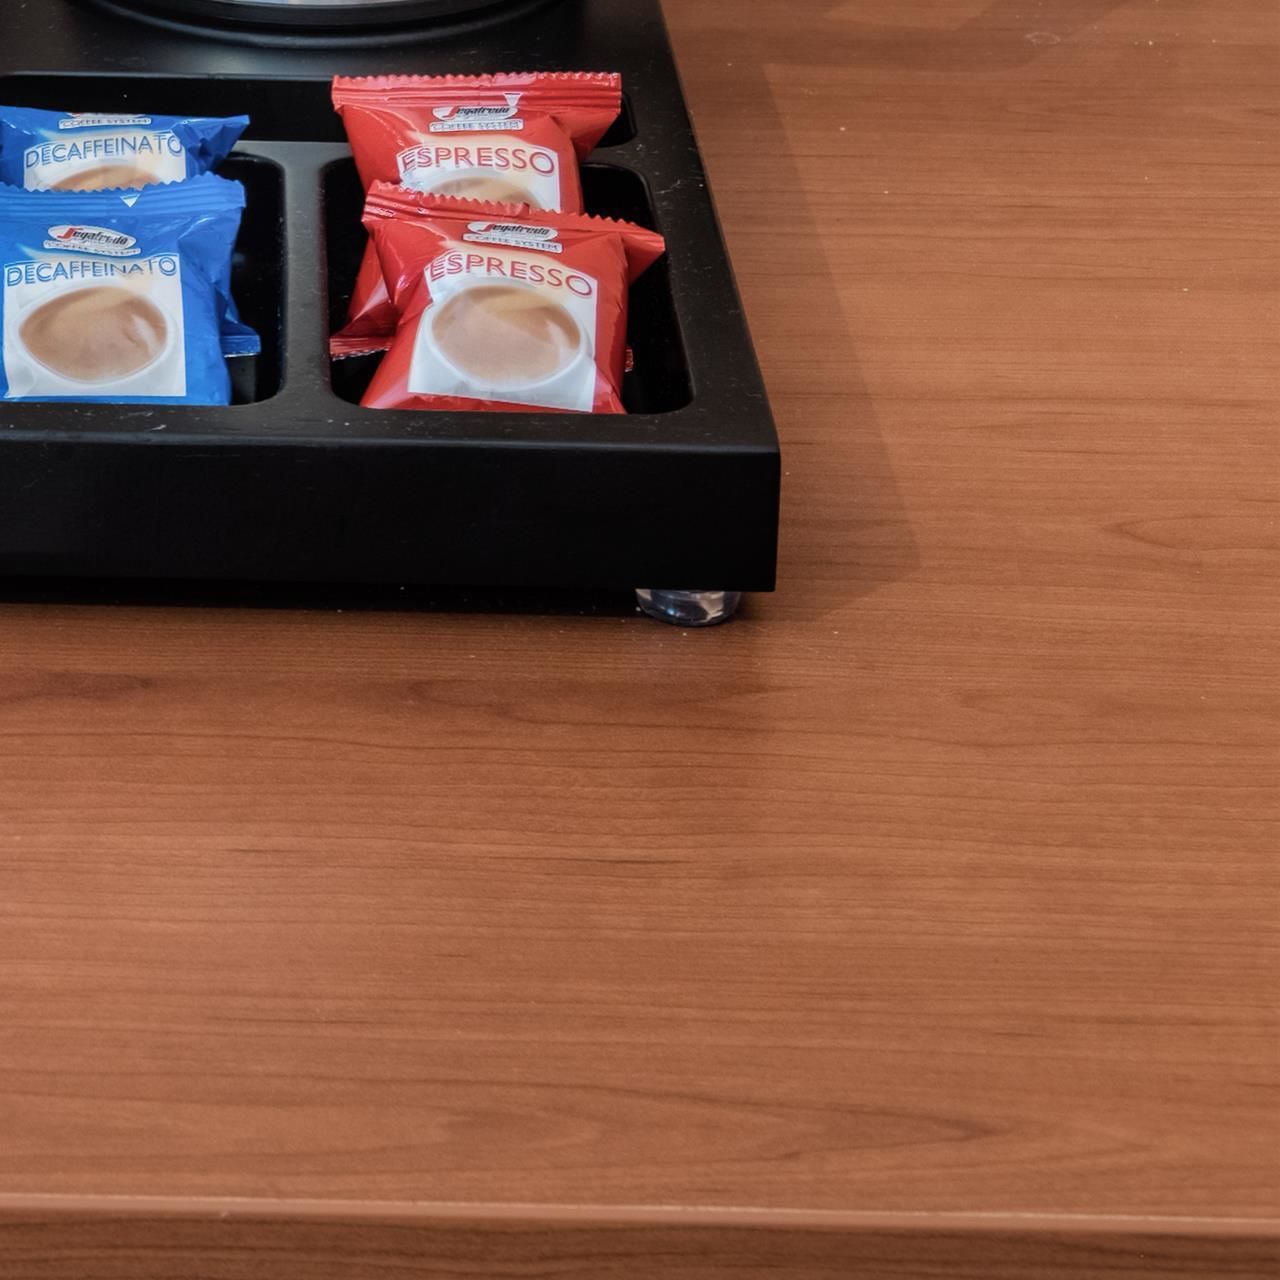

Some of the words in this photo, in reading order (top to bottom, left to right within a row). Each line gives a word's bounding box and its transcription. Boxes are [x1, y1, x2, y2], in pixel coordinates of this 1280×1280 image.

[25, 133, 184, 169] DECAFFEINATO
[401, 146, 555, 175] ESPRESSO
[56, 227, 129, 245] Segafredo
[476, 222, 550, 236] Segafredo
[6, 255, 178, 288] DECAFFEINATO
[429, 254, 593, 297] ESPRESSO
